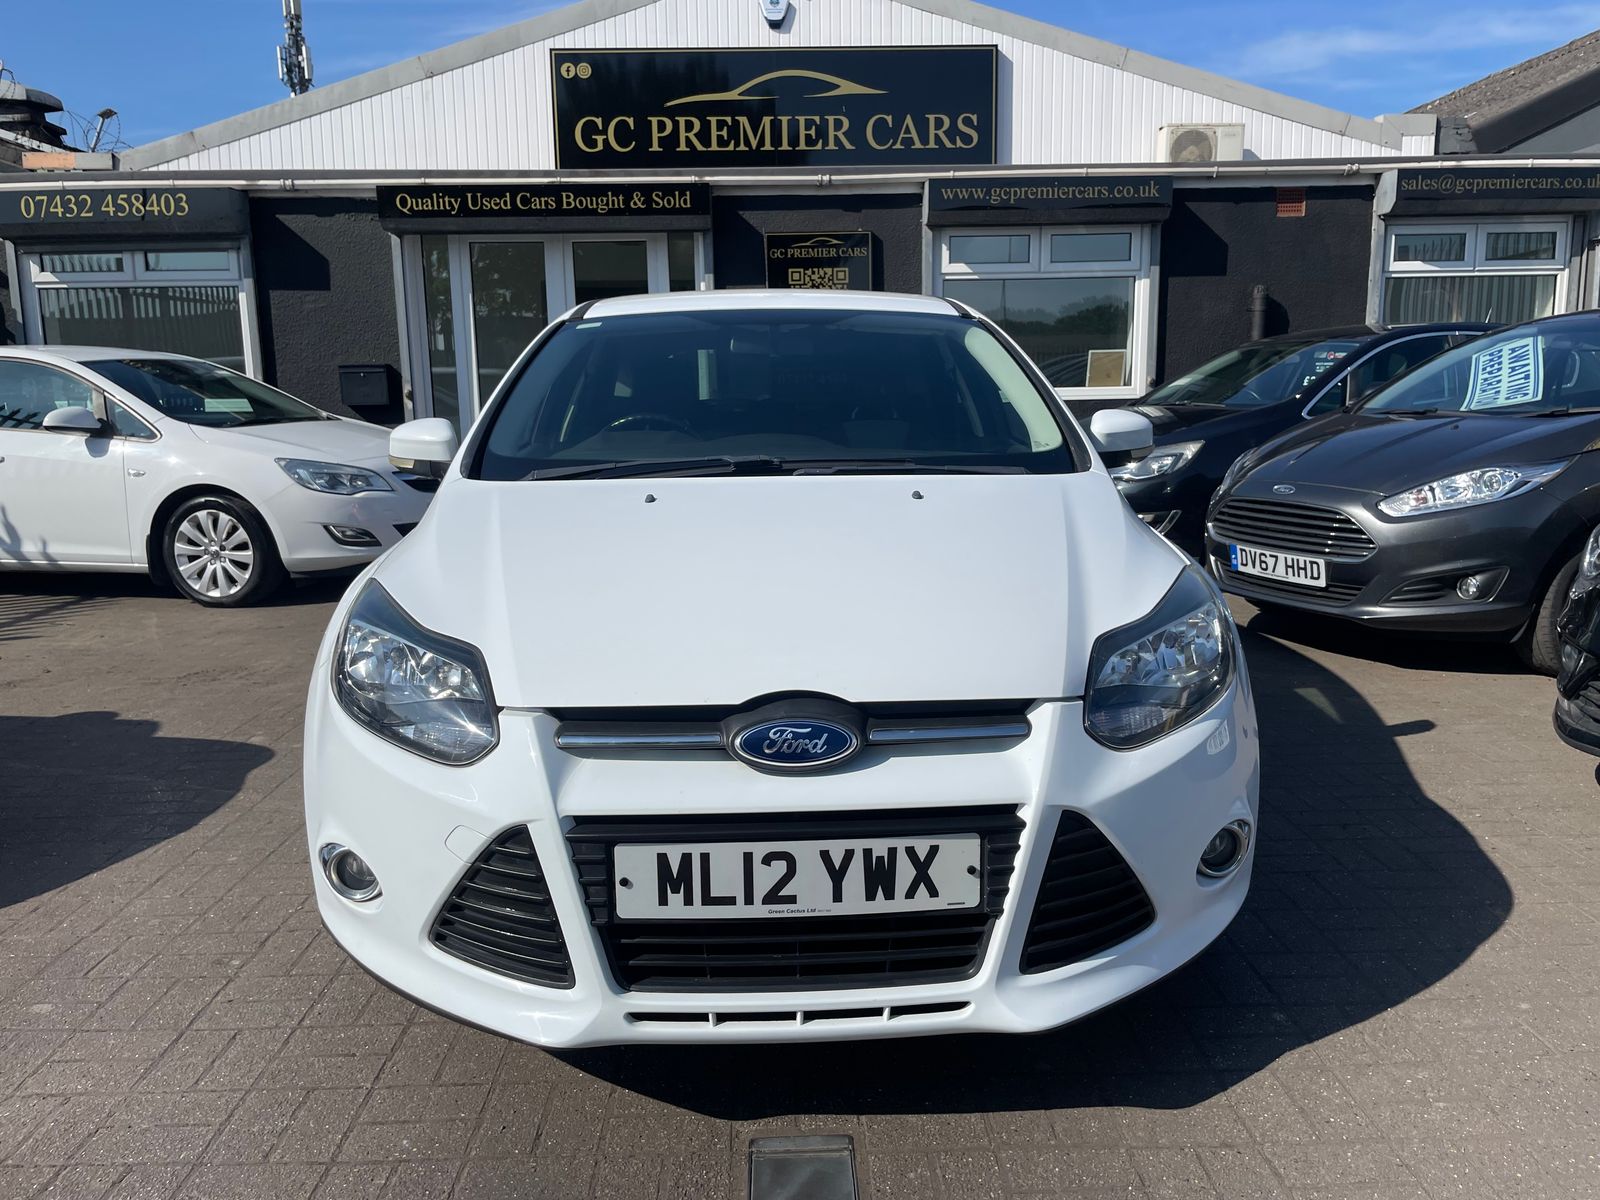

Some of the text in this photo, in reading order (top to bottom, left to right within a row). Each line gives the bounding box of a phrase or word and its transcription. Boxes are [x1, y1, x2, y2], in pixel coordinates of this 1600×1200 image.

[574, 112, 980, 153] GC PREMIER CARS
[395, 191, 691, 214] Quality Used Cars Bought & Sold
[940, 180, 1160, 204] www.gcpremiercars.co.uk
[20, 193, 190, 220] 07432 458403
[769, 247, 868, 258] GC PREMIER CARS
[1504, 343, 1530, 401] AWAITING
[1239, 547, 1321, 581] DV67 HHD
[762, 726, 828, 754] Ford
[656, 844, 940, 907] ML12 YWX
